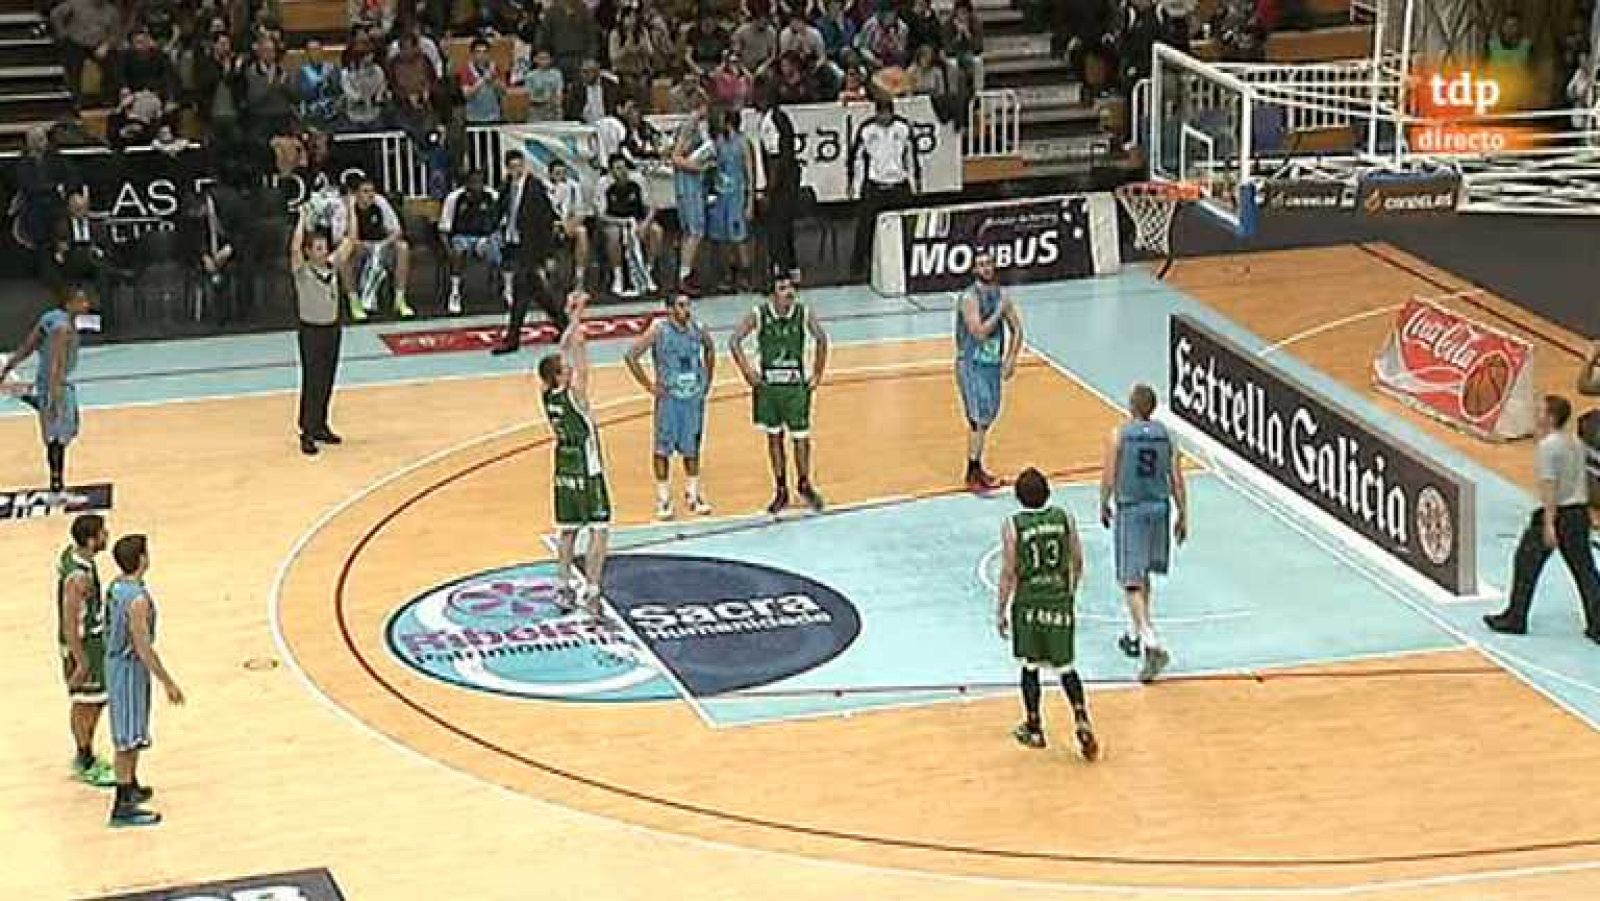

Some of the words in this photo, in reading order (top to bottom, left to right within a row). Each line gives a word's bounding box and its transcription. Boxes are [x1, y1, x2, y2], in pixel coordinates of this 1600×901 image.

[1173, 337, 1285, 468] Estrella
[1290, 408, 1408, 543] Galicia
[1028, 539, 1061, 569] 13
[629, 594, 820, 630] Sacra
